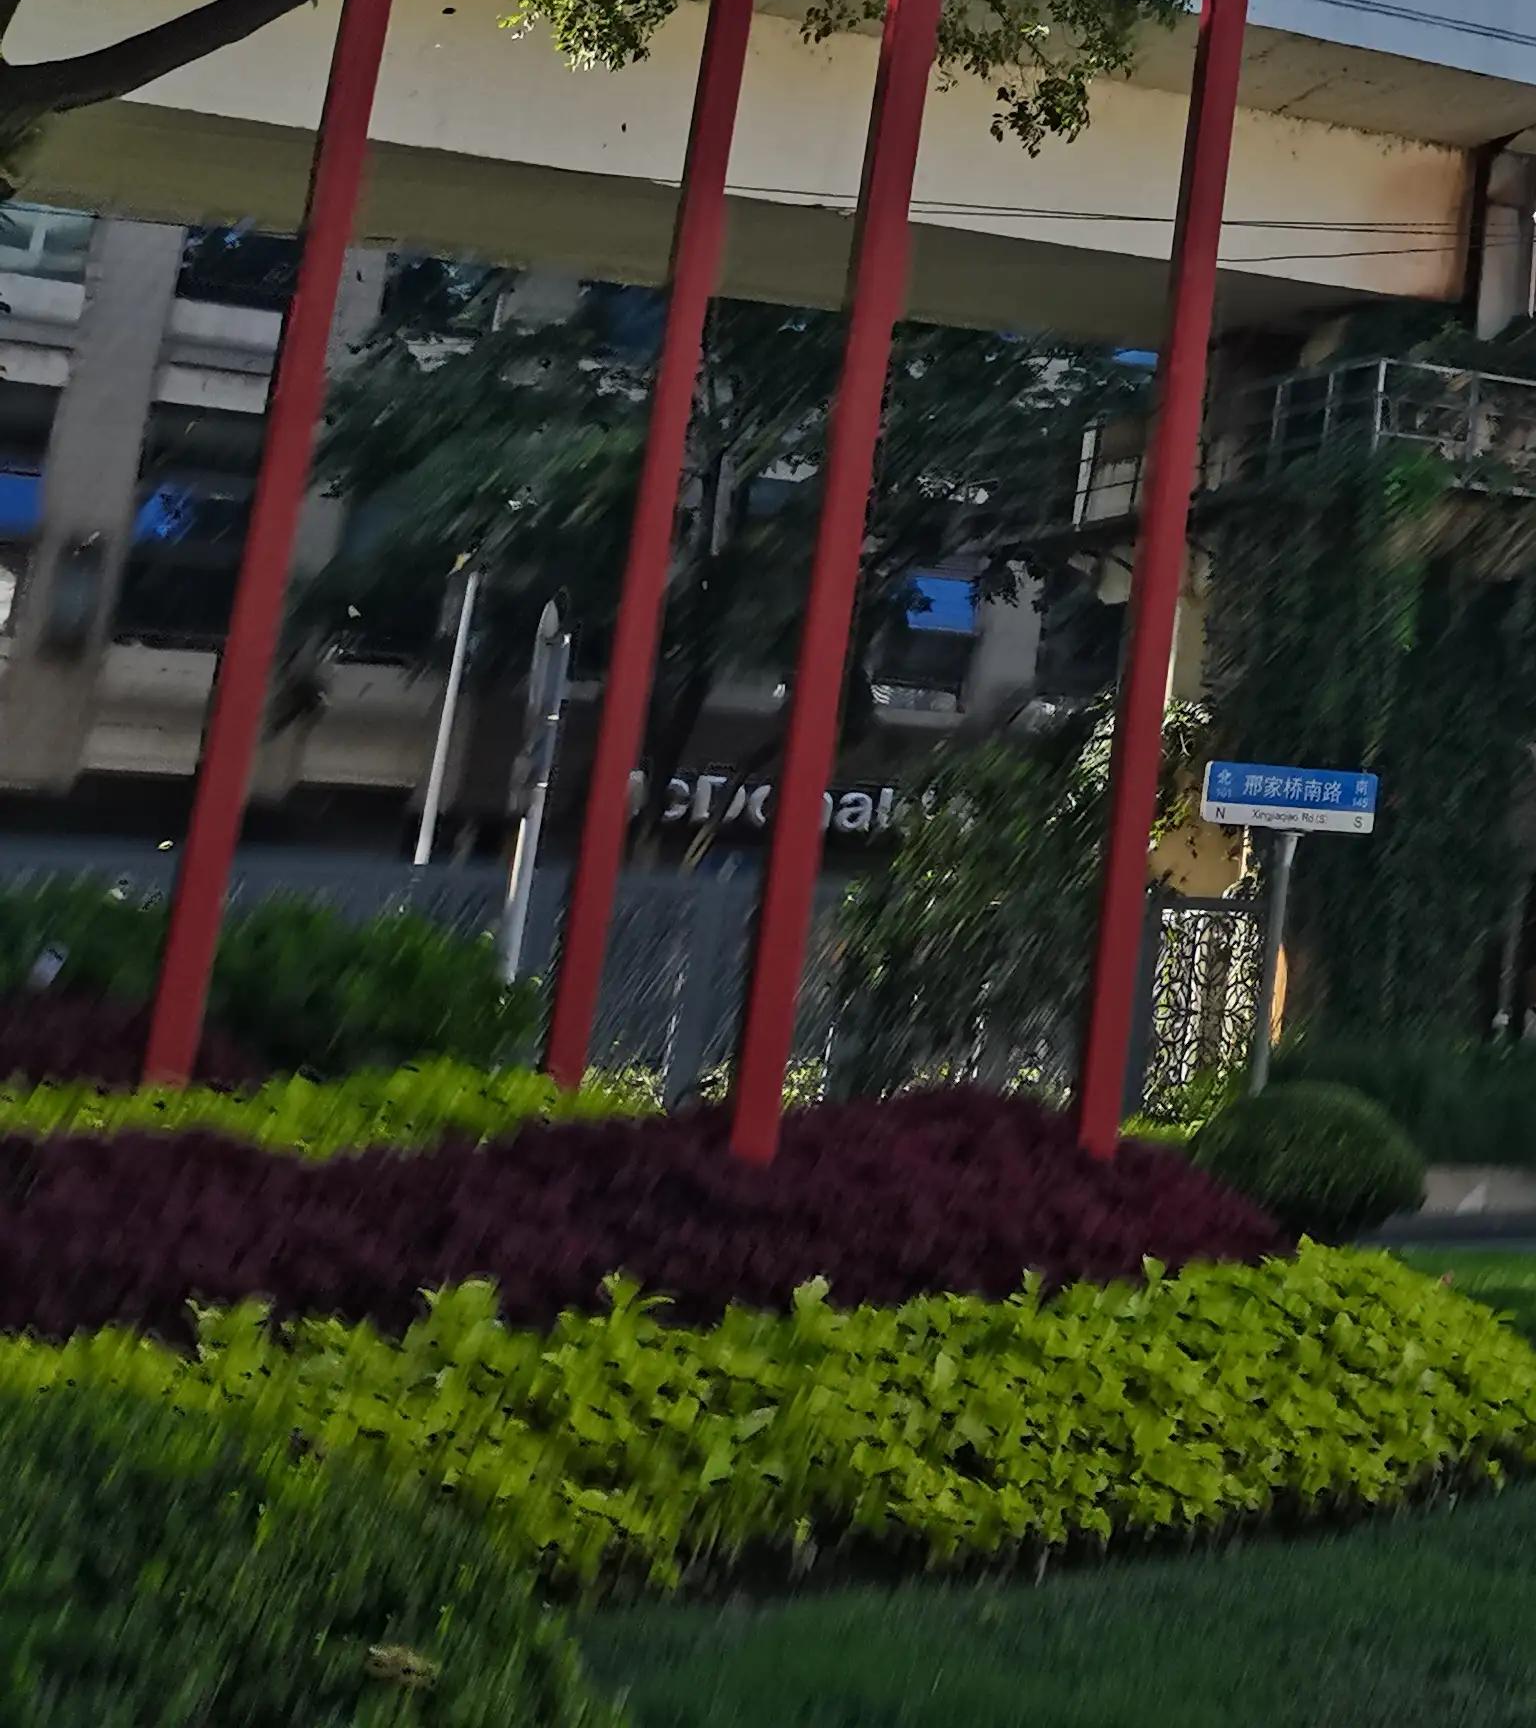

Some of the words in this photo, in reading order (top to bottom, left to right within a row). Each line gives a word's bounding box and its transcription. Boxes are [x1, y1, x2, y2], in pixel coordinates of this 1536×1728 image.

[1243, 774, 1343, 804] 邢家桥南路
[1215, 807, 1226, 819] N
[1353, 817, 1363, 828] S
